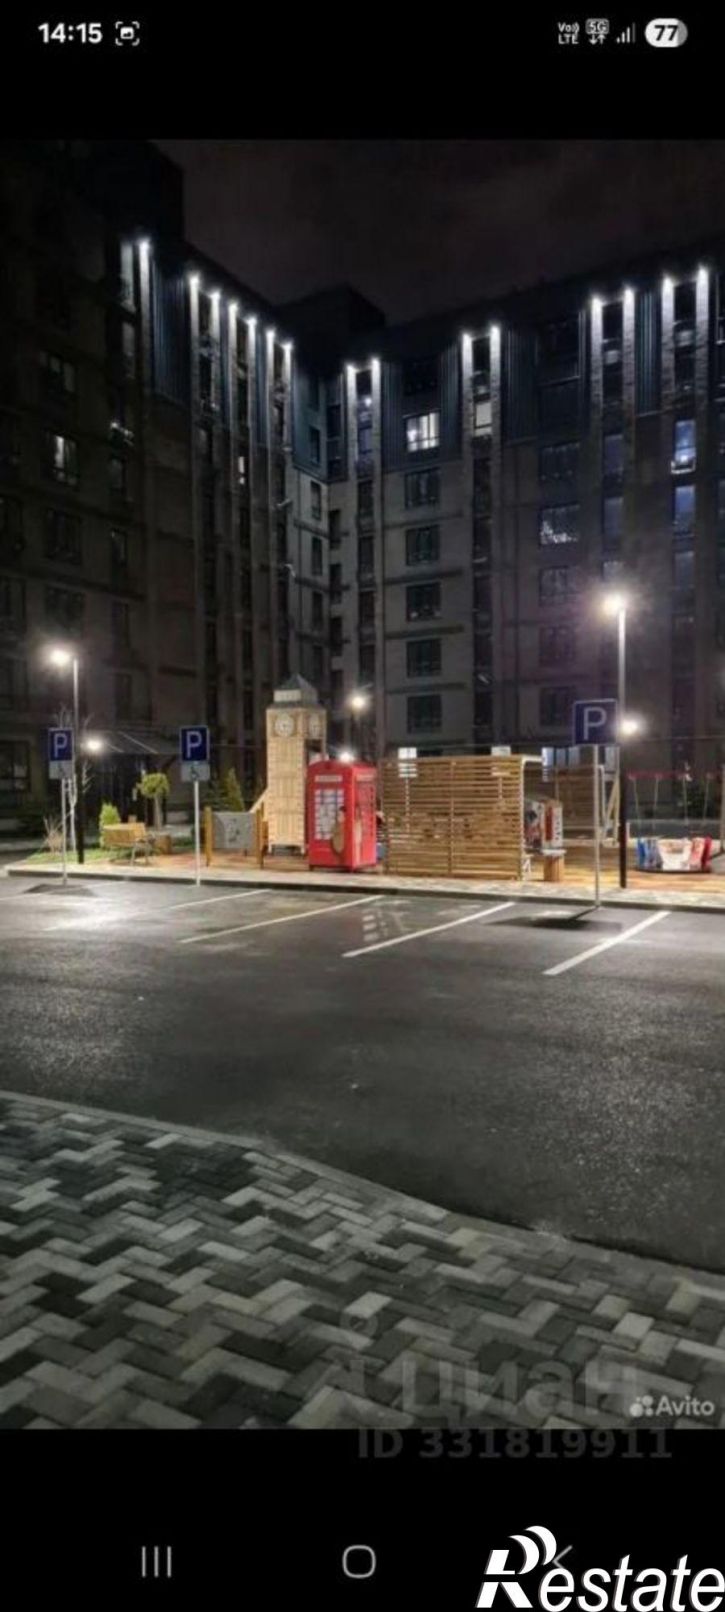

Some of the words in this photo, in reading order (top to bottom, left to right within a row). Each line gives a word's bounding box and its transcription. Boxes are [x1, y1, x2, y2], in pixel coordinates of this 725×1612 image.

[583, 706, 607, 740] P
[53, 734, 68, 758] P
[186, 730, 203, 758] P
